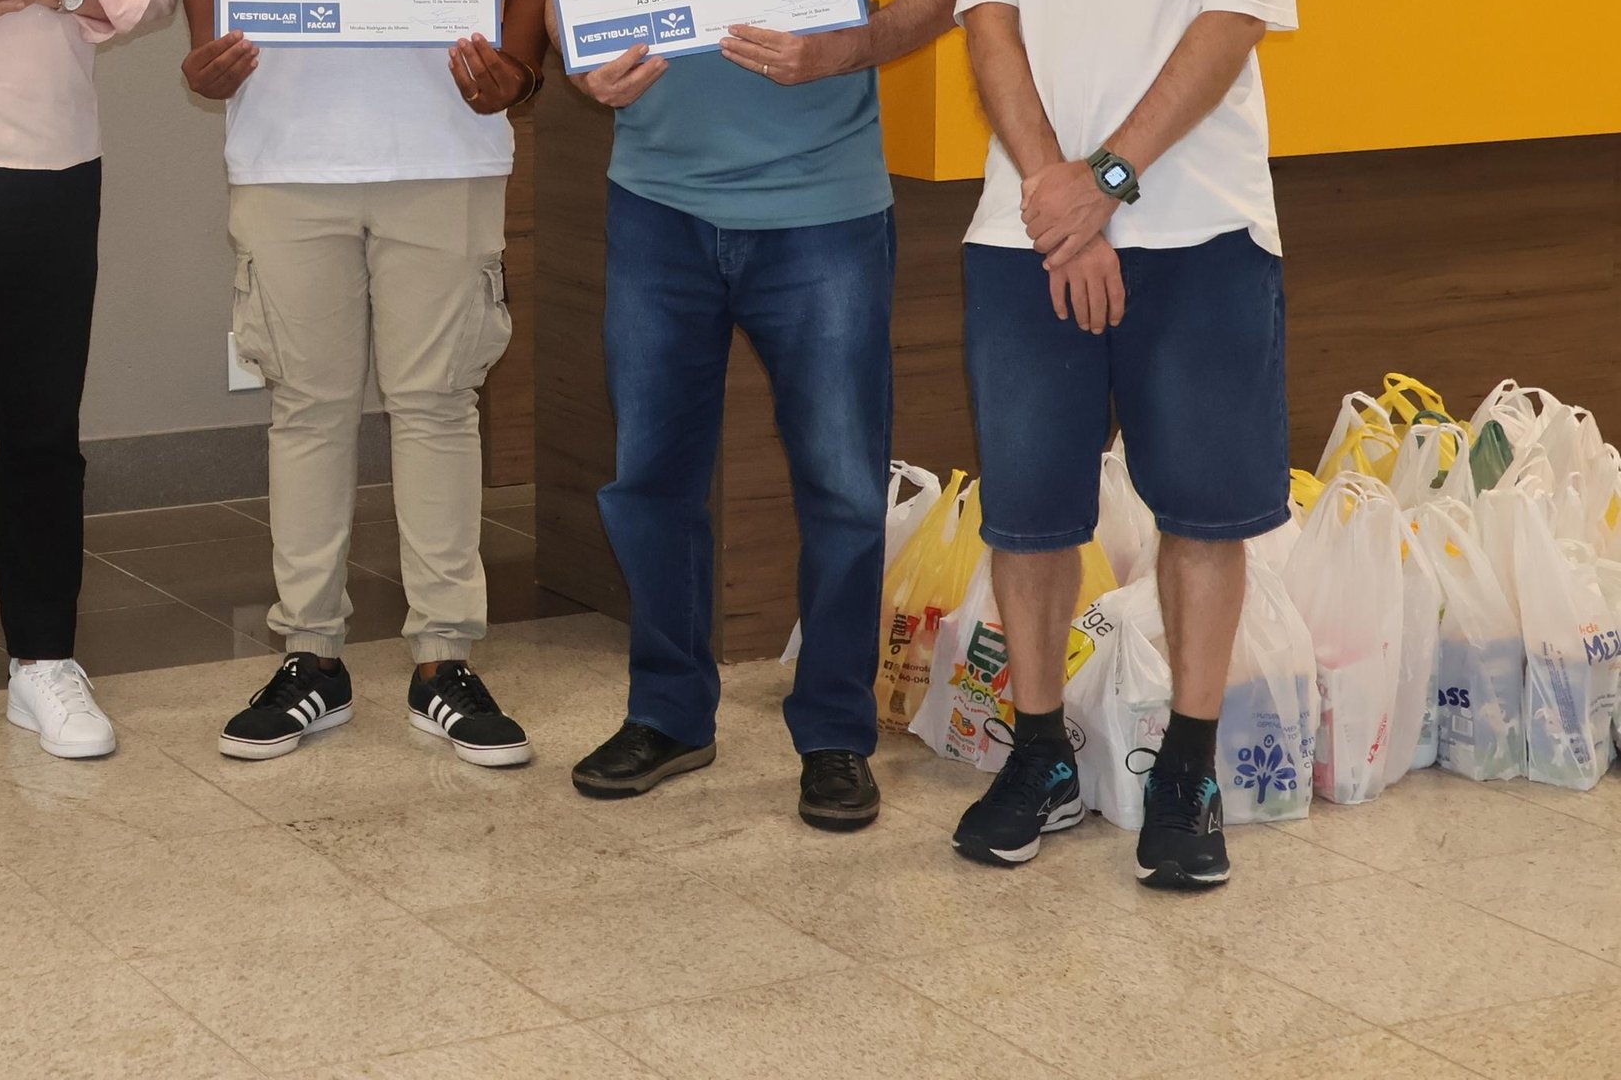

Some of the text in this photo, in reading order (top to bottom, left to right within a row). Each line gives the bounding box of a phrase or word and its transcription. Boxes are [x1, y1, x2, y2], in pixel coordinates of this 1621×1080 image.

[232, 12, 297, 21] VESTIBULAR
[307, 21, 336, 29] FACCAT
[580, 25, 648, 43] VESTIBULAR
[660, 27, 690, 39] FACCAT
[1083, 603, 1114, 637] iga
